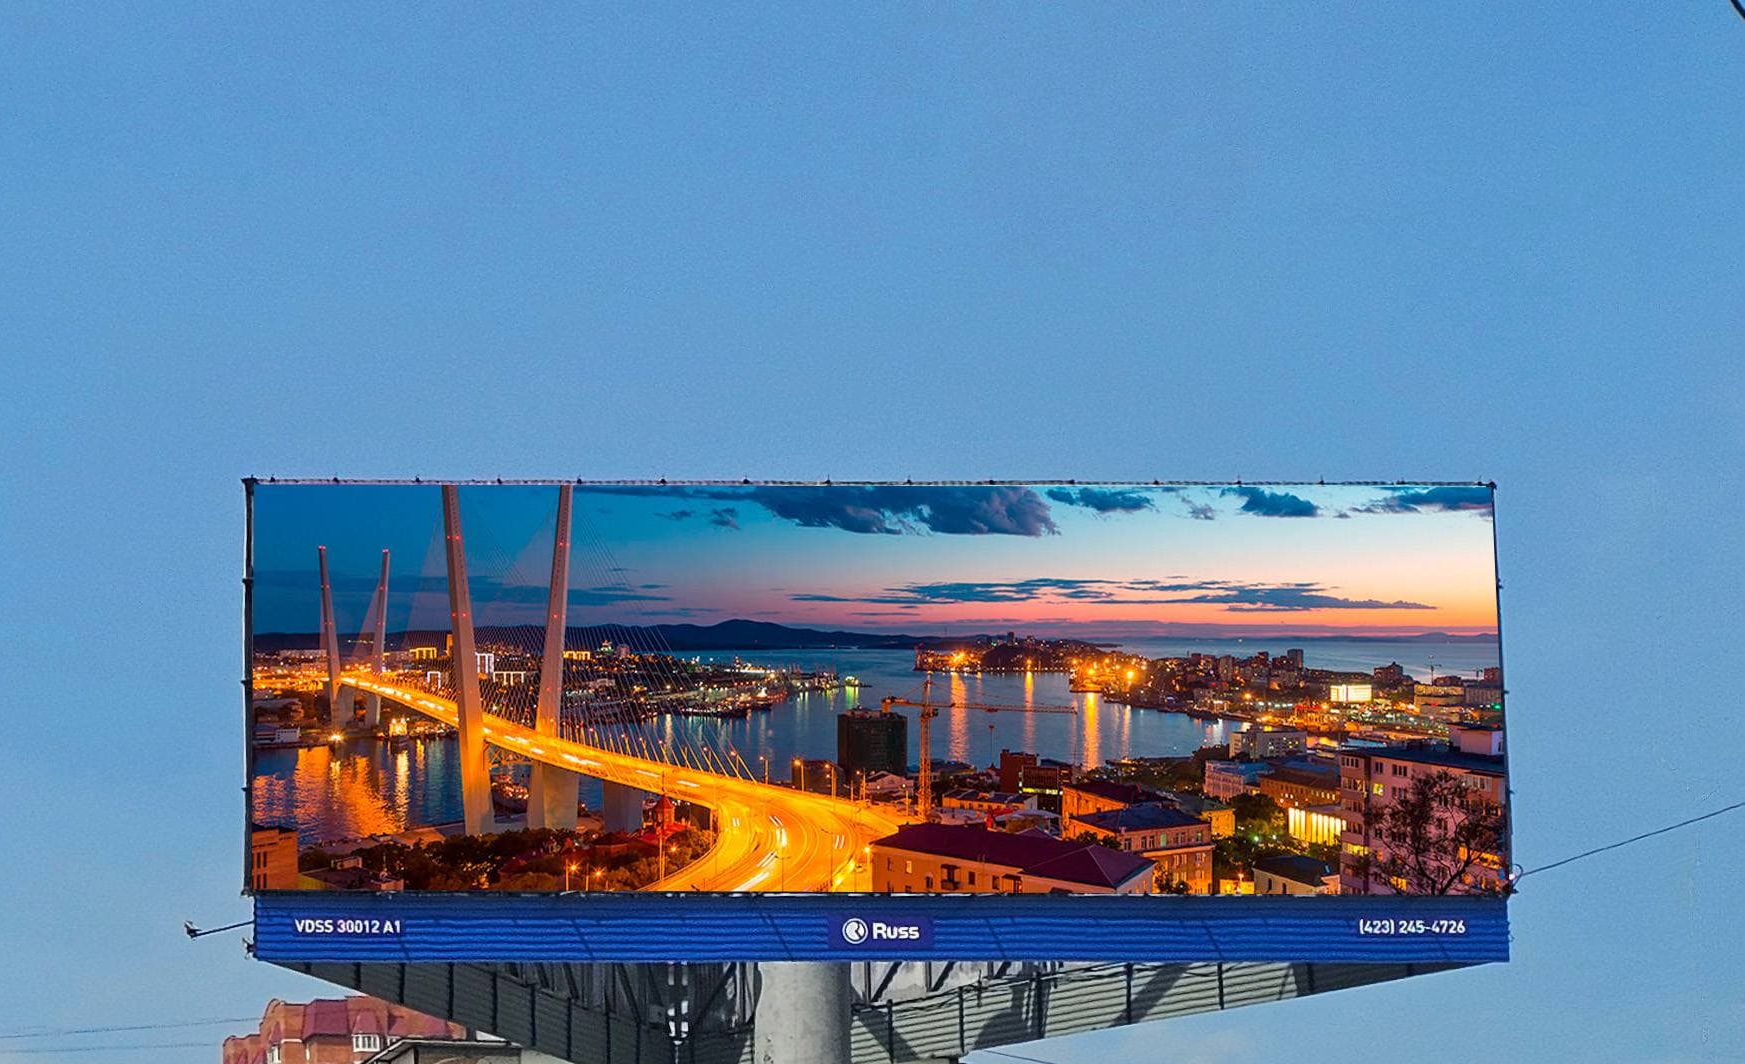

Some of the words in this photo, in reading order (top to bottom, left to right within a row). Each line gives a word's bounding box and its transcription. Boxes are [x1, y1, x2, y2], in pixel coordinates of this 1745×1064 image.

[295, 919, 334, 933] VDSS
[337, 920, 380, 933] 30012
[383, 920, 401, 933] A1
[873, 922, 920, 939] Russ
[1359, 919, 1394, 934] (423)
[1399, 920, 1466, 934] 245-4726
